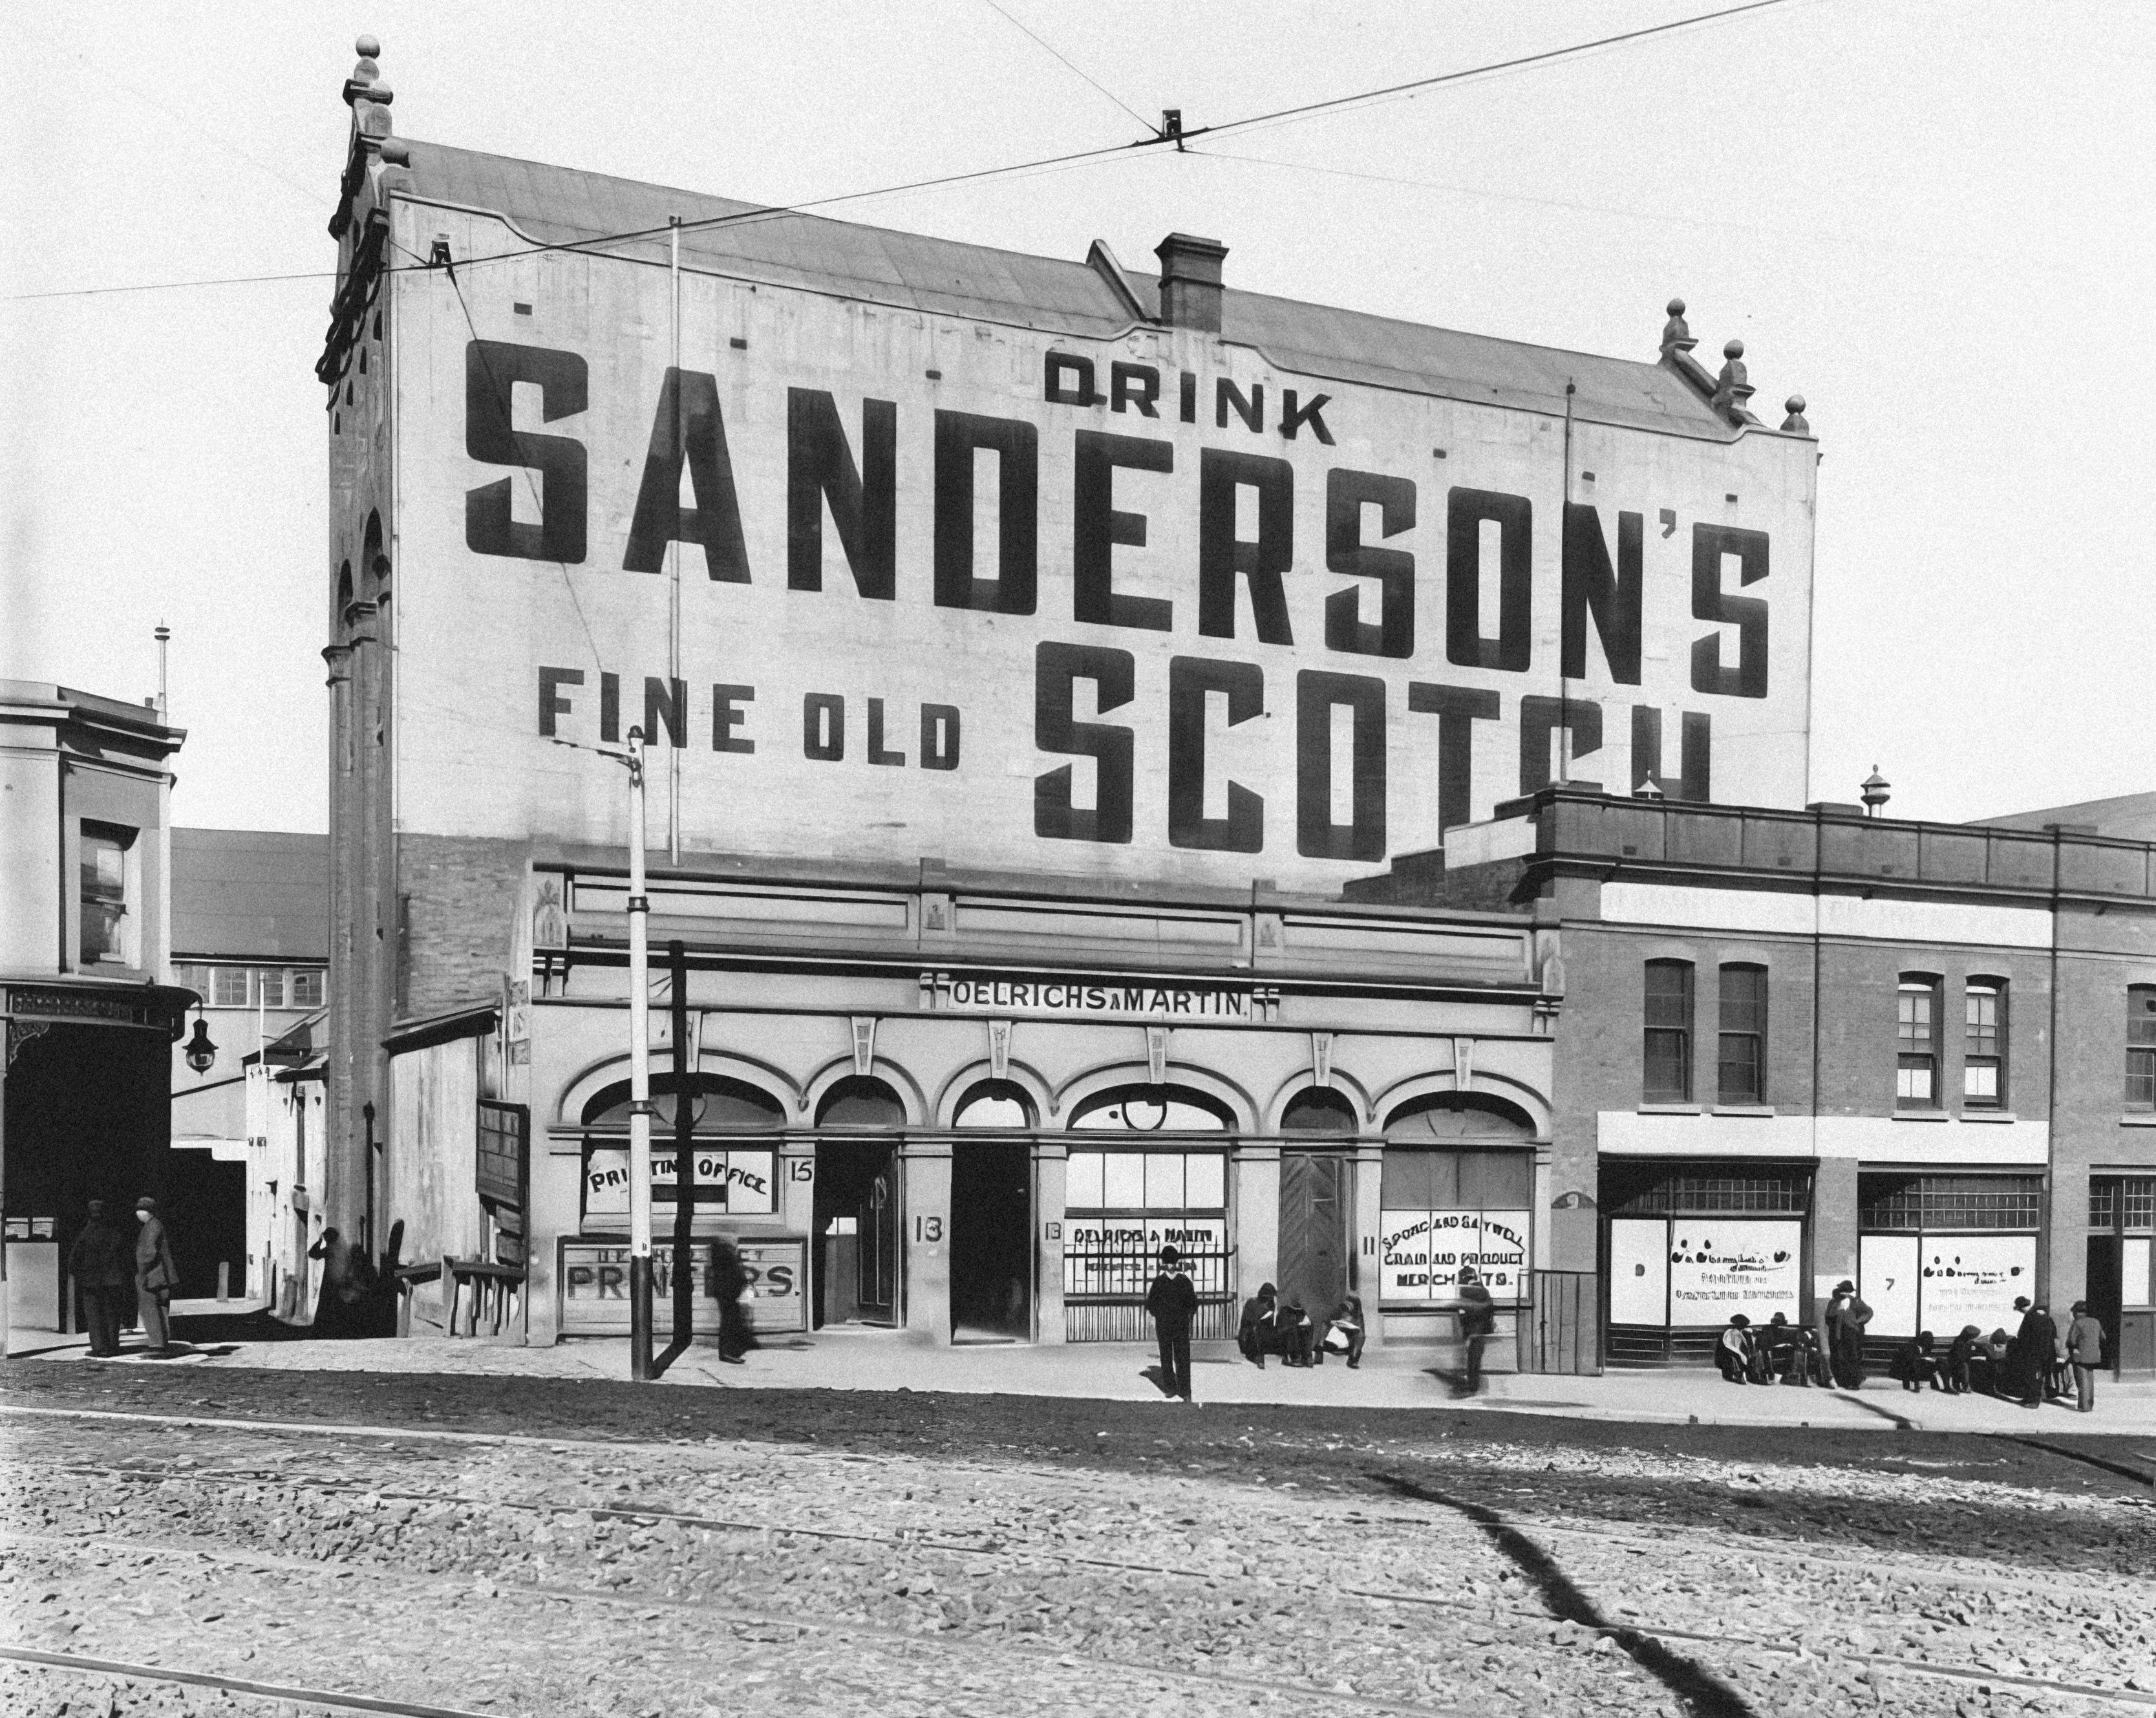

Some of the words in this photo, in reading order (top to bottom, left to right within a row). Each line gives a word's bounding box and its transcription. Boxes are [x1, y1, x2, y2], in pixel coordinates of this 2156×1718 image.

[1044, 350, 1337, 446] DRINK
[465, 339, 1770, 699] SANDERSON'S
[538, 666, 755, 754] FINE
[804, 692, 961, 771] OLD
[954, 981, 1107, 1010] OELRICHS
[698, 1159, 767, 1196] OFFICE
[791, 1161, 813, 1181] 15
[1885, 1278, 1895, 1291] 7
